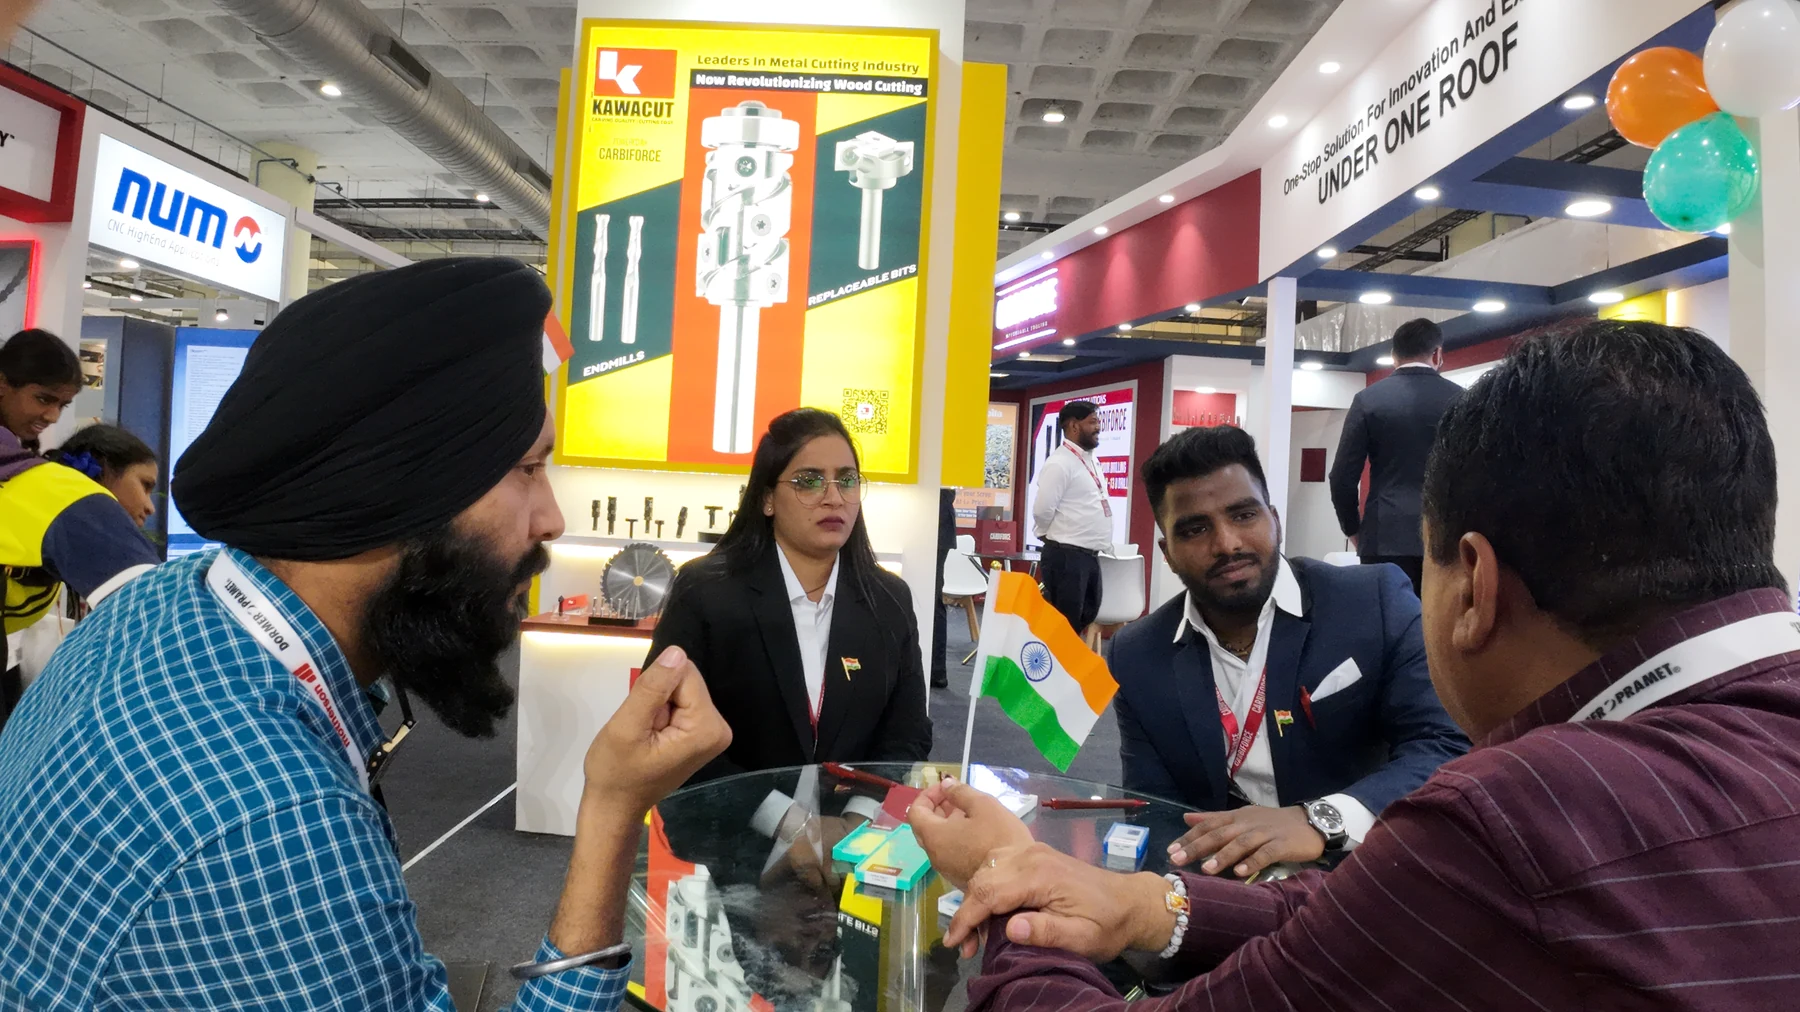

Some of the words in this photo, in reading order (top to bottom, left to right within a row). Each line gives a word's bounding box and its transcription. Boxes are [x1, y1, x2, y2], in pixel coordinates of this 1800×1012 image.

[697, 55, 750, 67] Leaders
[753, 56, 766, 67] In
[769, 57, 808, 69] Metal
[811, 58, 859, 72] Cutting
[863, 60, 920, 74] Industry
[695, 73, 726, 86] Now
[727, 74, 832, 92] Revolutionizing
[833, 78, 873, 91] Wood
[874, 80, 923, 96] Cutting
[1283, 155, 1322, 196] One-Stop
[1324, 118, 1364, 162] Solution
[1367, 98, 1386, 127] For
[1389, 37, 1459, 108] Innovation
[1463, 0, 1496, 48] And
[592, 98, 675, 118] KAWACUT
[1318, 134, 1378, 205] UNDER
[1384, 90, 1431, 154] ONE
[1439, 21, 1518, 118] ROOF
[598, 147, 661, 162] CARBIFORCE
[112, 166, 228, 249] num
[107, 218, 126, 234] CNC
[127, 226, 166, 248] HighEnd
[807, 270, 890, 306] REPLACEABLE
[890, 263, 917, 282] BITS
[582, 350, 646, 378] ENDMILLS
[224, 580, 251, 608] PRAMET
[252, 612, 290, 652] DORMER
